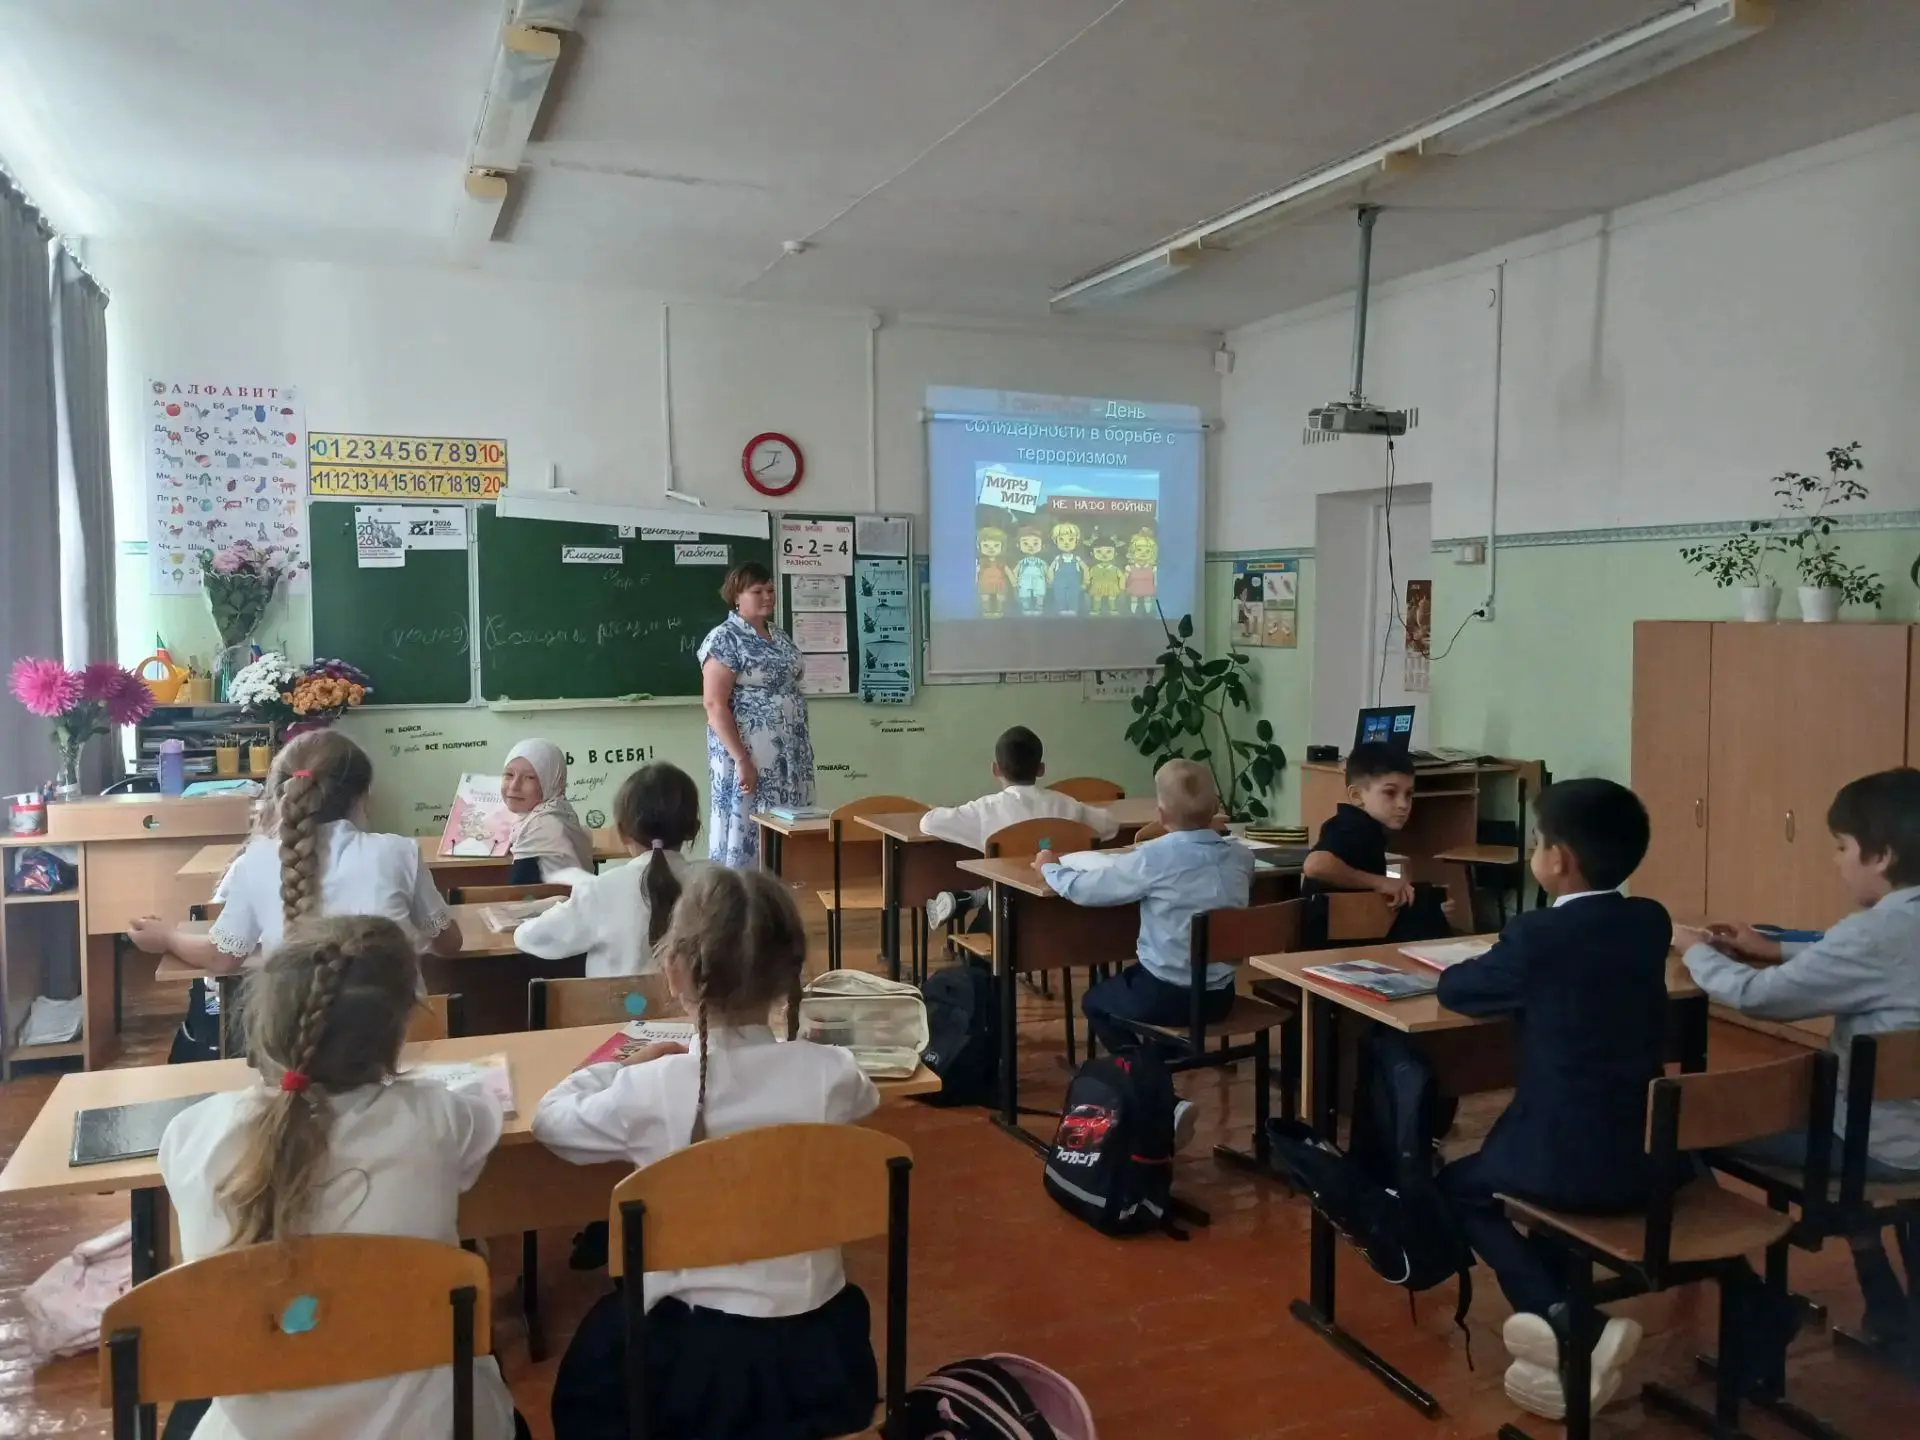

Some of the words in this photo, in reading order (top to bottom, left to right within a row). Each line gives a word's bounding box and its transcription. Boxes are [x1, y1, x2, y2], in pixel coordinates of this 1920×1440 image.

[171, 383, 279, 399] АЛФАВИТ
[1105, 400, 1146, 419] День
[1091, 428, 1099, 438] в
[1104, 424, 1162, 445] борьбе
[1166, 433, 1176, 444] с
[316, 439, 327, 456] 0
[330, 439, 339, 458] 1
[346, 439, 359, 459] 2
[363, 440, 376, 459] 3
[380, 441, 393, 460] 4
[398, 441, 410, 461] 5
[415, 442, 427, 461] 6
[431, 442, 444, 462] 7
[449, 443, 461, 462] 8
[465, 444, 477, 462] 9
[479, 444, 500, 463] 10
[1017, 448, 1128, 466] терроризмом
[317, 471, 331, 489] 11
[334, 471, 350, 489] 12
[352, 472, 368, 490] 13
[371, 473, 388, 490] 14
[391, 473, 407, 491] 15
[410, 474, 426, 492] 16
[428, 475, 444, 492] 17
[447, 475, 462, 492] 18
[465, 475, 480, 493] 19
[483, 476, 501, 493] 20
[986, 475, 1028, 491] МИРУ
[1052, 499, 1067, 509] НЕ
[1074, 500, 1105, 511] НАДО
[357, 525, 373, 535] 20
[358, 536, 373, 546] 26
[783, 538, 793, 555] 6
[808, 539, 818, 554] 2
[838, 540, 848, 555] 4
[564, 548, 621, 561] Классная
[785, 559, 822, 567] РАЗНОСТЬ
[398, 725, 421, 733] БОЙСЯ
[589, 749, 598, 763] В
[816, 763, 850, 771] УЛЫБАЙСЯ
